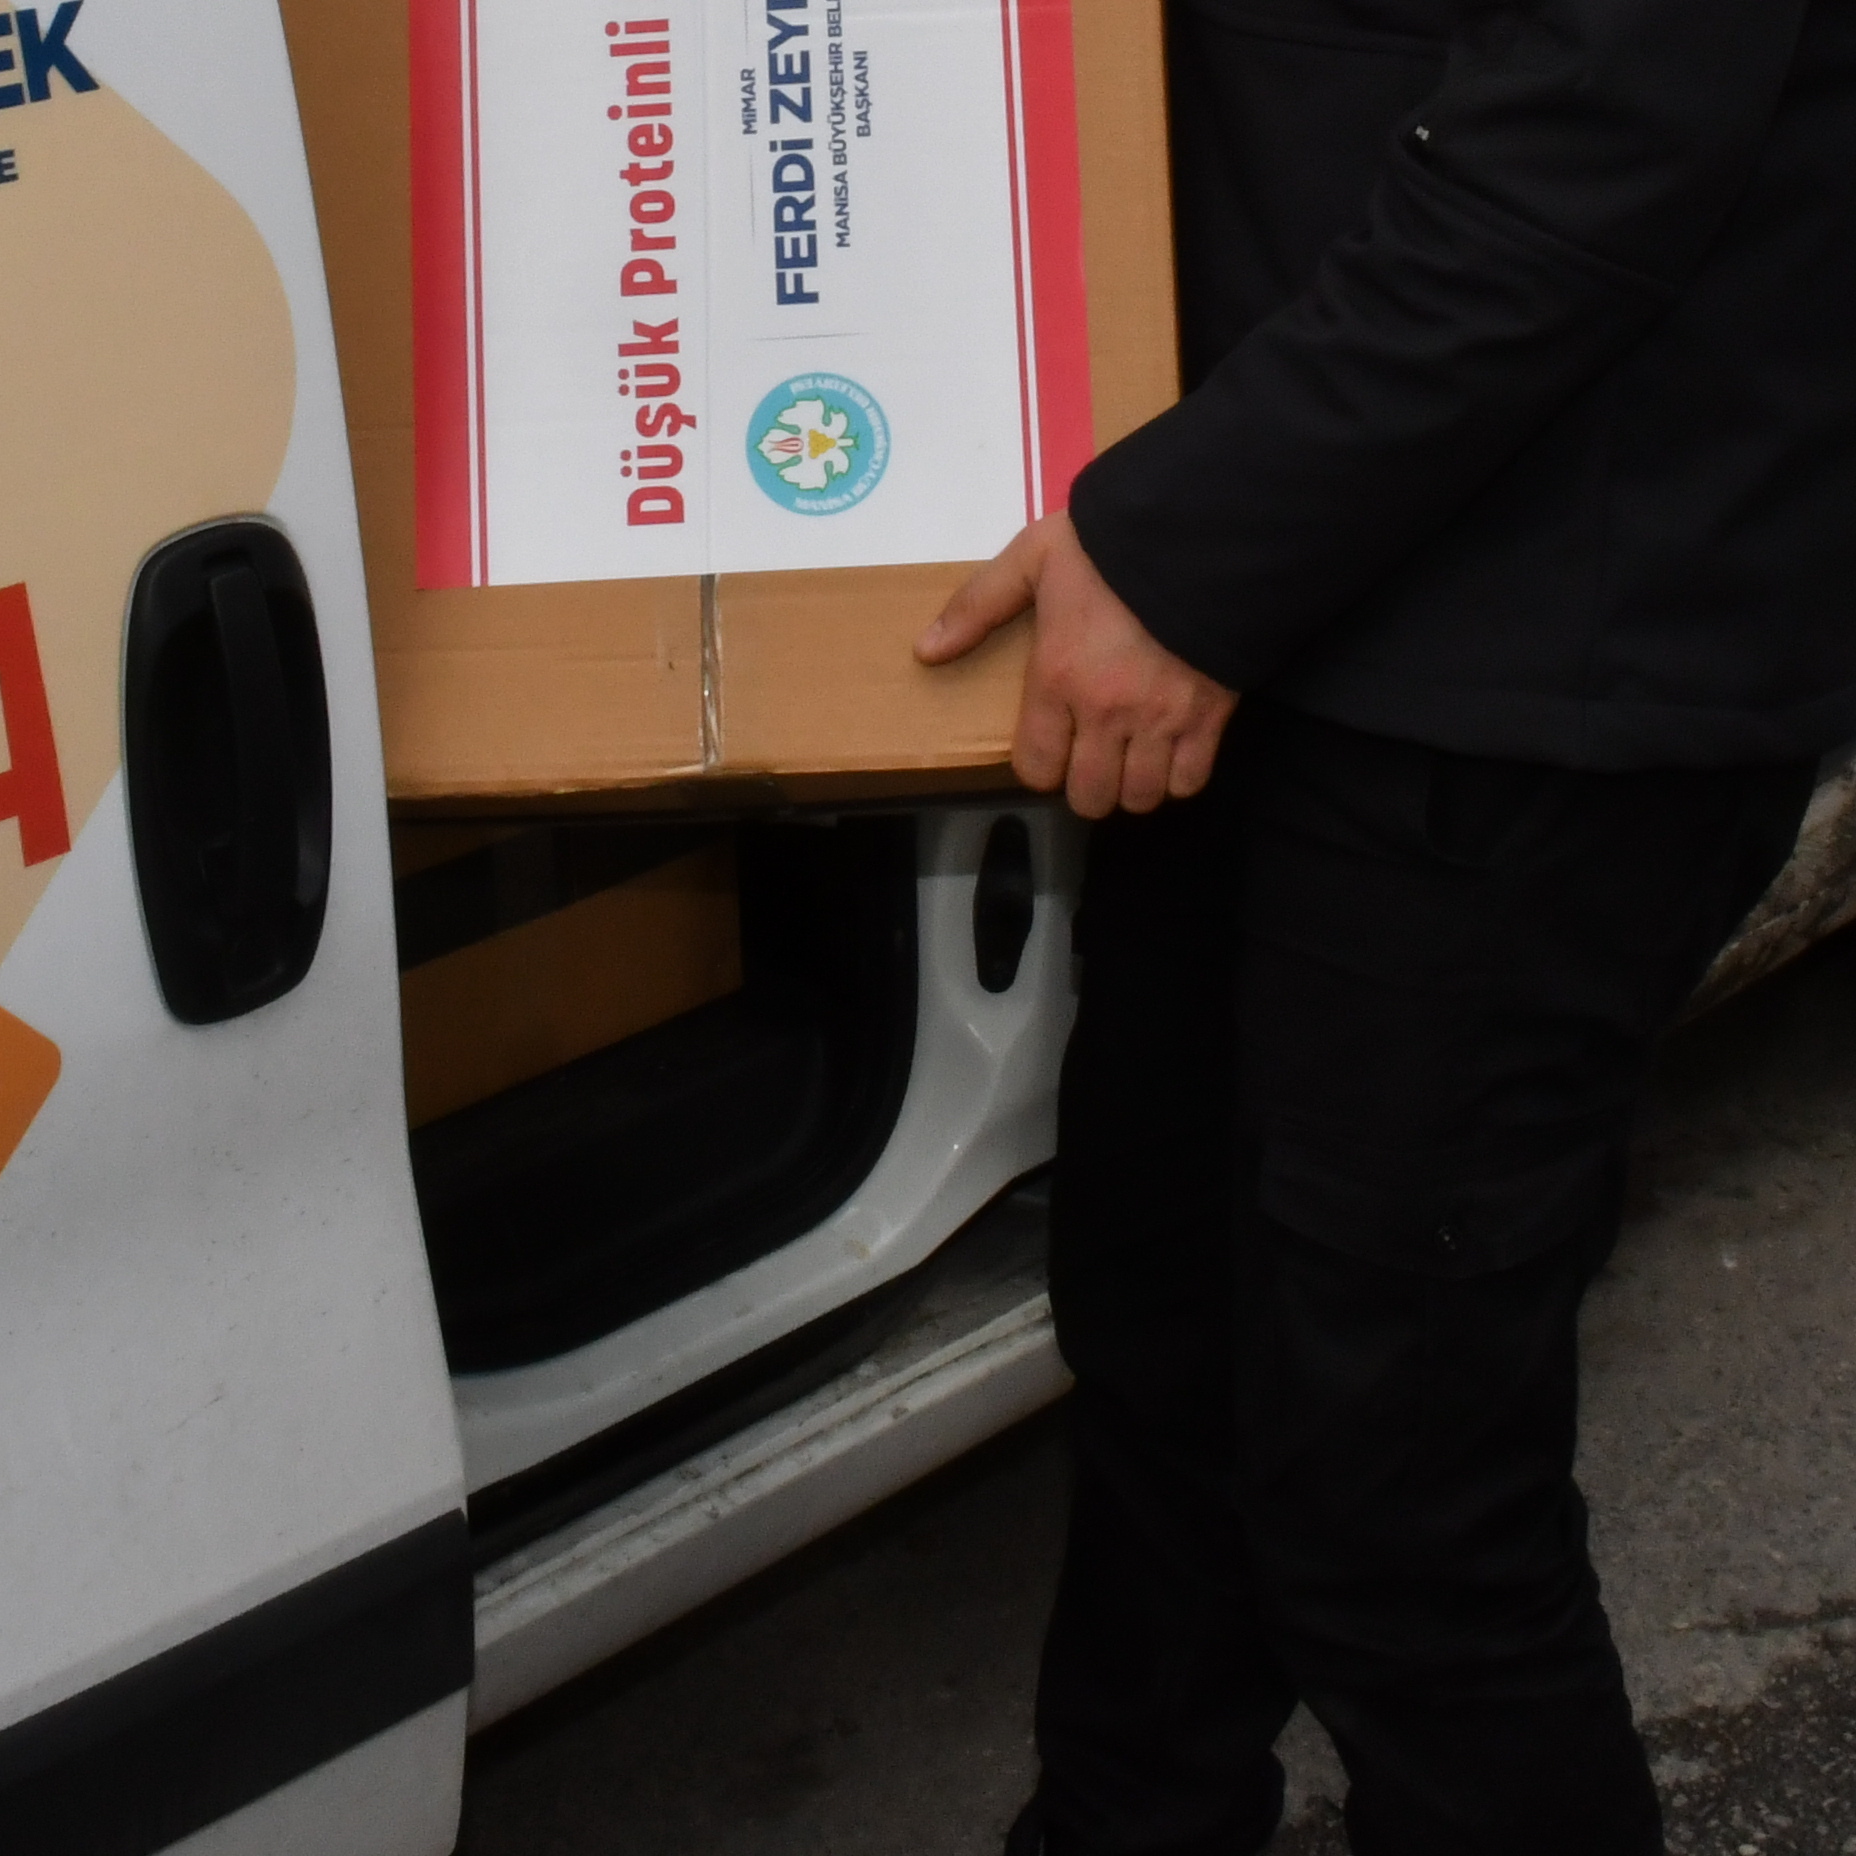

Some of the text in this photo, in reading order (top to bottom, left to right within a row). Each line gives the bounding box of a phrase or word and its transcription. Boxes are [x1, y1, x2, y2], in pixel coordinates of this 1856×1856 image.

[605, 18, 677, 297] Proteinli
[853, 50, 872, 138] BAŞKANI
[617, 318, 698, 526] Düşük
